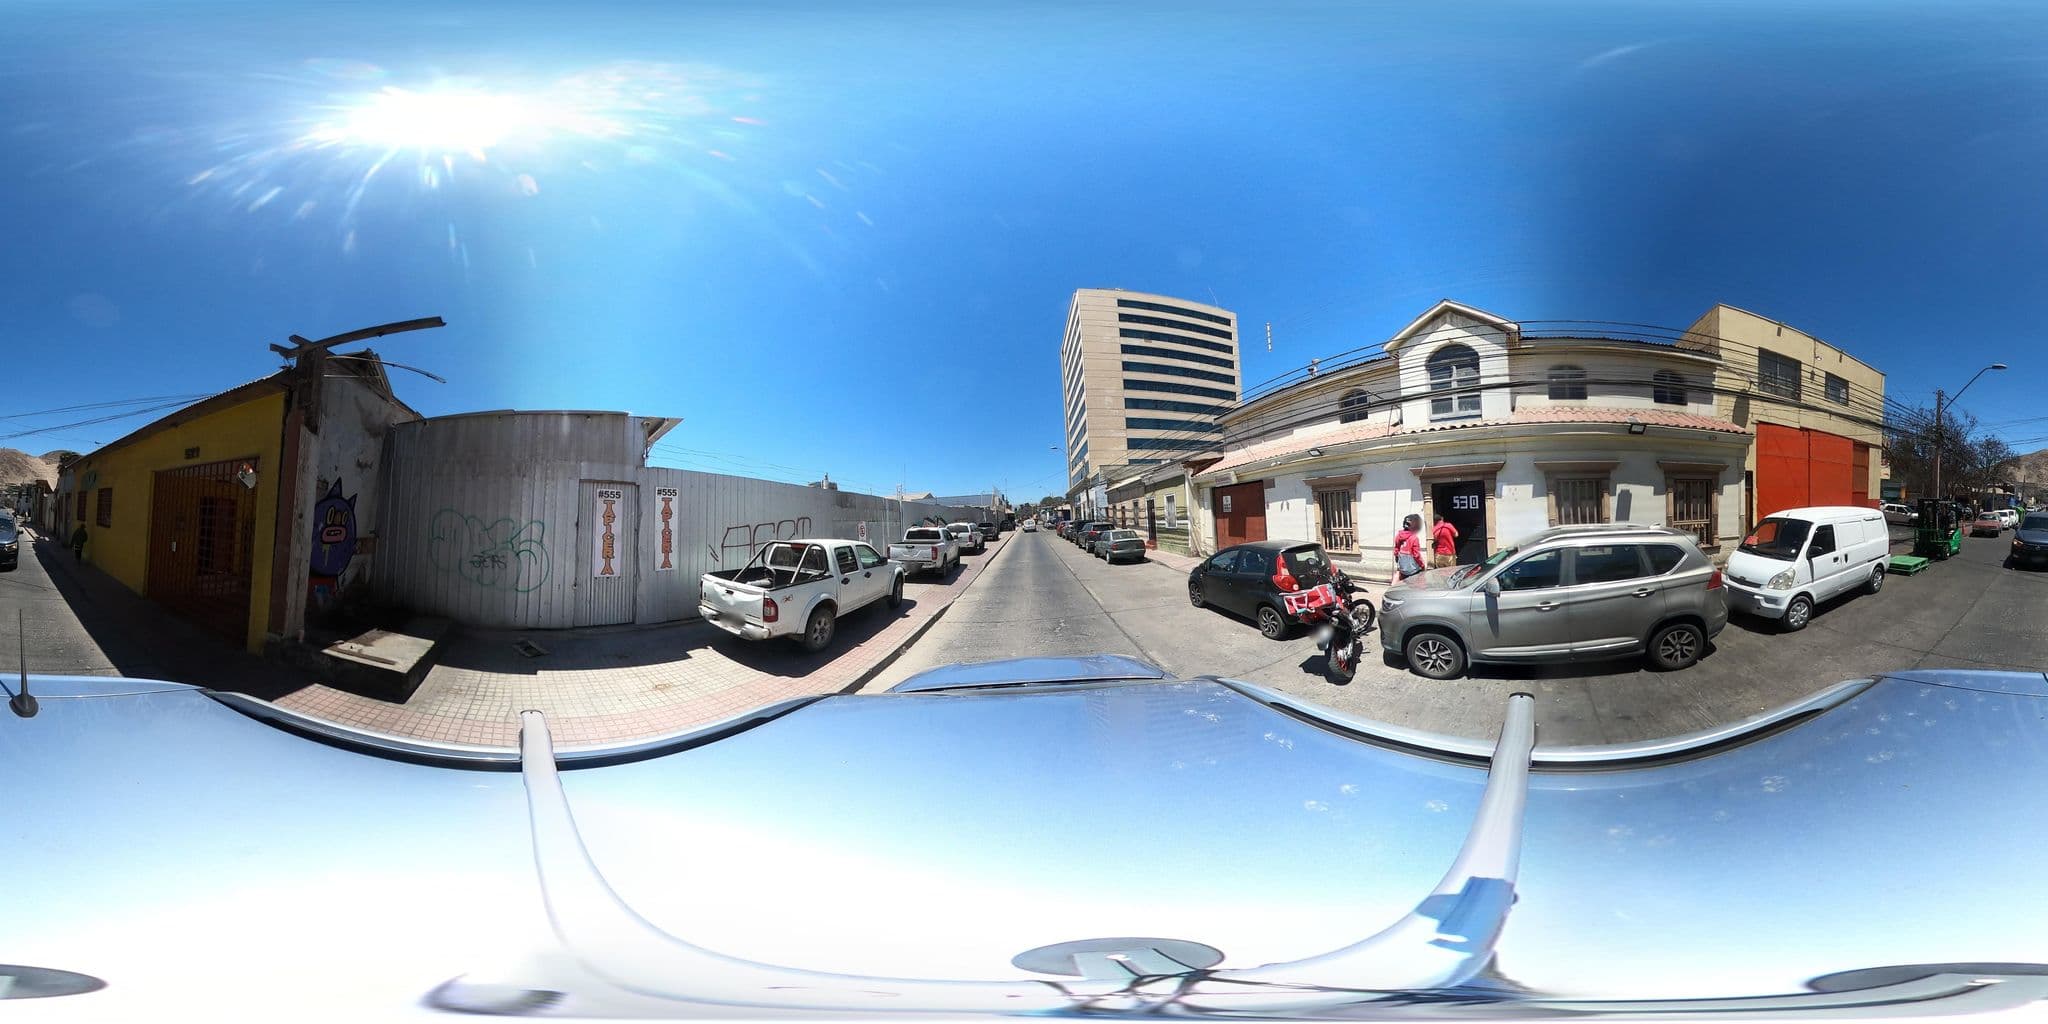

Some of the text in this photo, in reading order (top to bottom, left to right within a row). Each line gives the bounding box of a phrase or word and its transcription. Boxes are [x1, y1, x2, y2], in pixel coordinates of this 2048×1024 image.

[598, 490, 621, 499] #555
[657, 488, 677, 496] #555
[1453, 495, 1479, 509] 530
[600, 500, 616, 575] TAPICERIA
[661, 497, 673, 569] TAPICERIA
